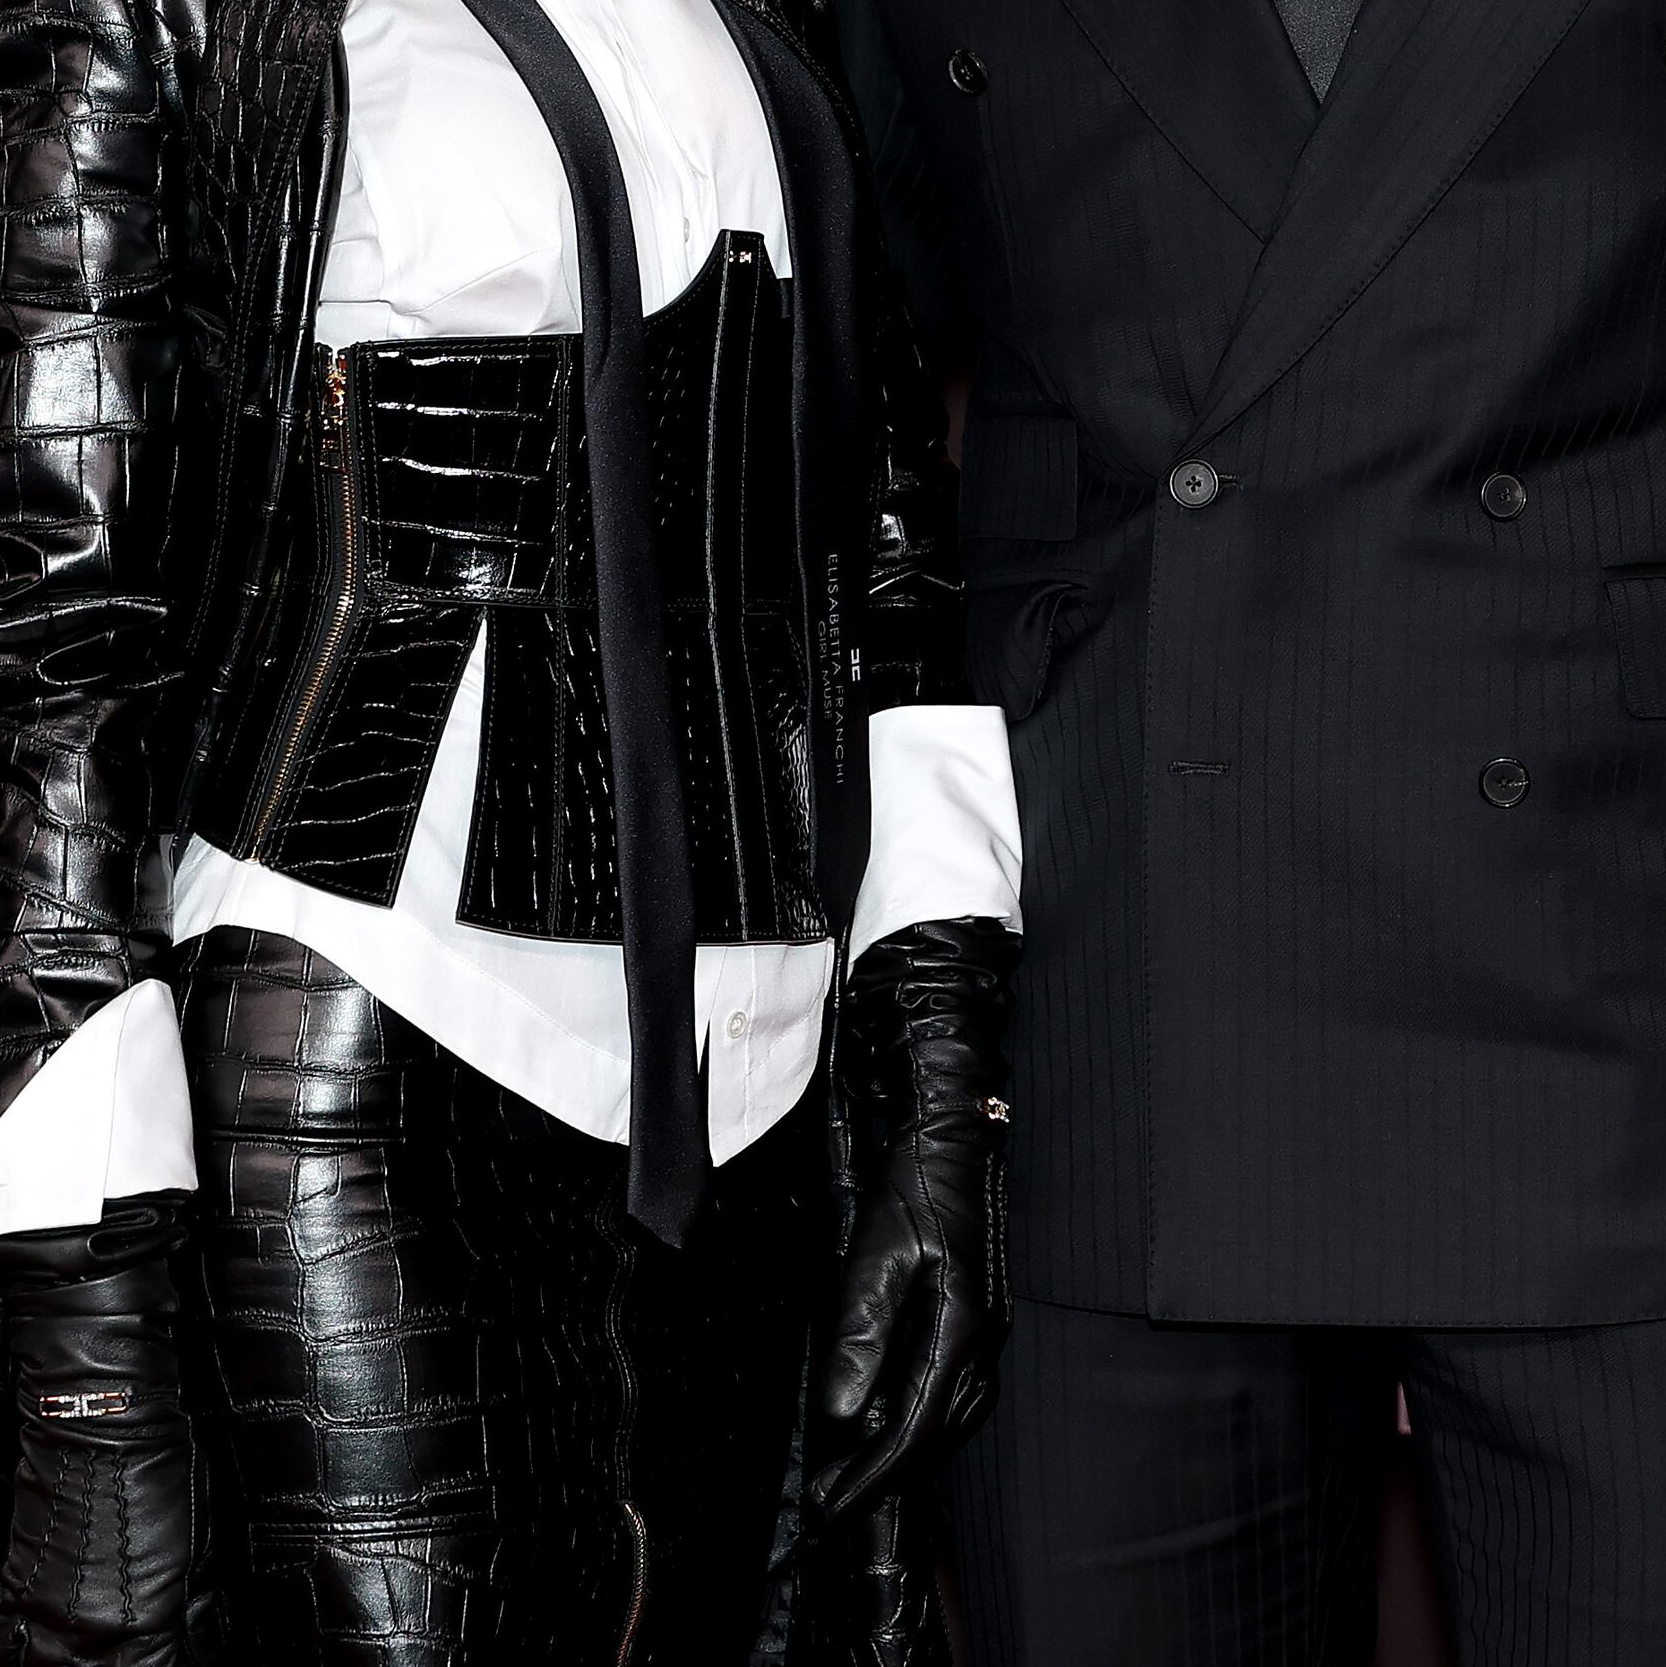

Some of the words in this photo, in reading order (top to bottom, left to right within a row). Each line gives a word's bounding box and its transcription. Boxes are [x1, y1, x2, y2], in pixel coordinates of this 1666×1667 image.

[820, 670, 832, 719] MUSE
[827, 554, 841, 676] ELISABETTA
[835, 685, 844, 783] FRANCHI
